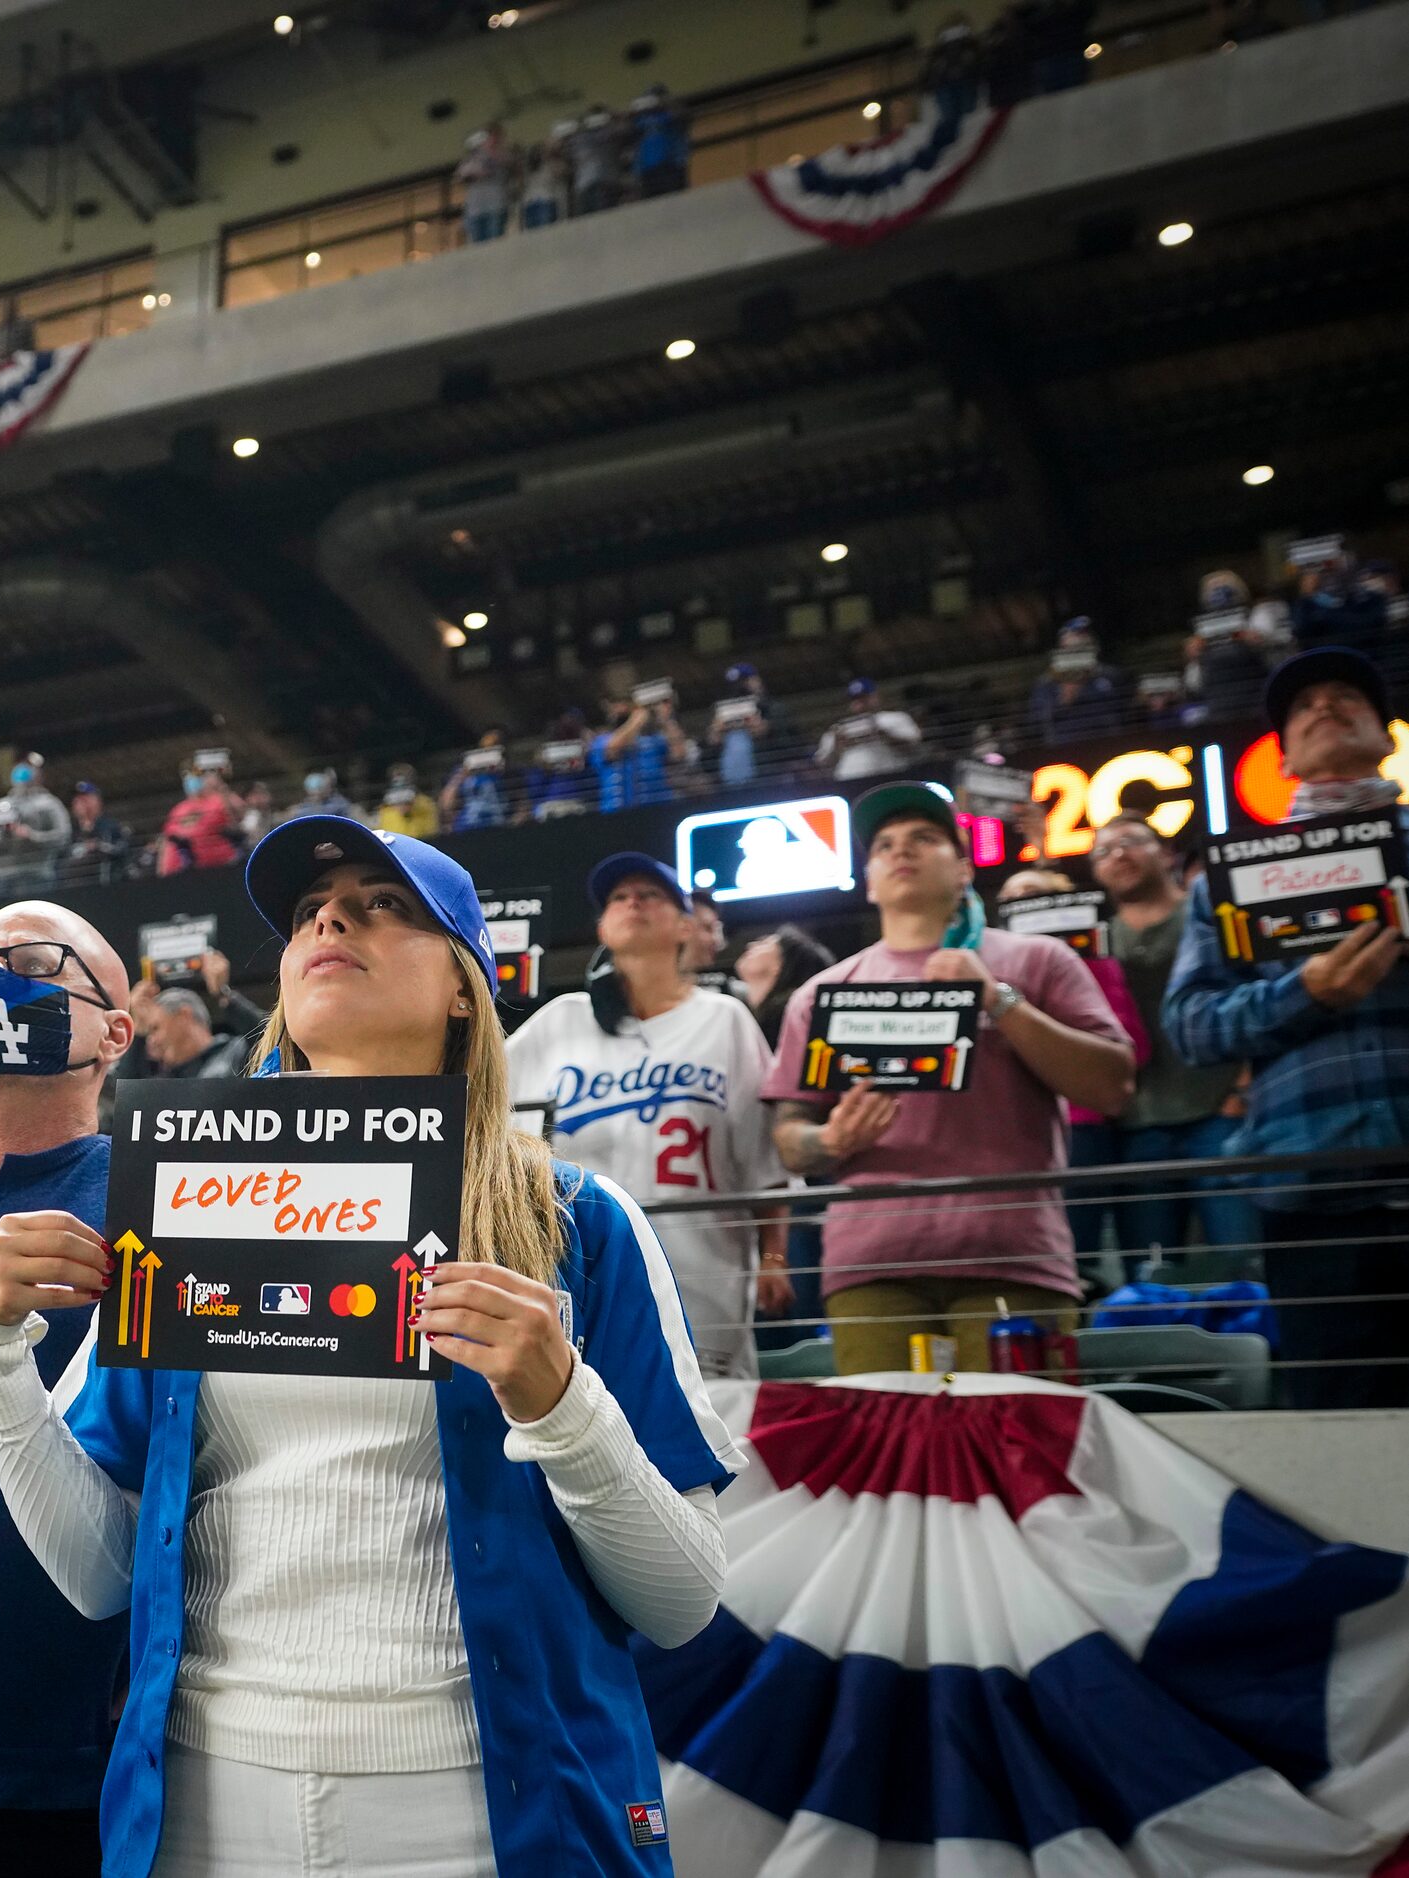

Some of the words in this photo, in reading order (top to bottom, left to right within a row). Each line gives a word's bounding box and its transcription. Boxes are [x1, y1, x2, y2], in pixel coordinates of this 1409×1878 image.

[1208, 846, 1221, 865] I
[1223, 834, 1302, 863] STAND
[1303, 828, 1340, 849] UP
[1342, 820, 1394, 844] FOR
[505, 899, 542, 917] FOR
[819, 992, 831, 1008] I
[831, 991, 899, 1008] STAND
[900, 991, 931, 1008] UP
[932, 990, 976, 1008] FOR
[547, 1056, 727, 1135] Dodgers
[131, 1110, 142, 1142] I
[154, 1109, 282, 1142] STAND
[296, 1109, 350, 1143] UP
[363, 1107, 444, 1142] FOR
[170, 1168, 302, 1210] LOVED
[274, 1198, 382, 1234] ONES
[195, 1283, 230, 1296] STAND
[195, 1294, 209, 1305] UP
[209, 1294, 223, 1305] TO
[193, 1305, 239, 1317] CANCER
[207, 1330, 339, 1351] StandUpToCancer.org
